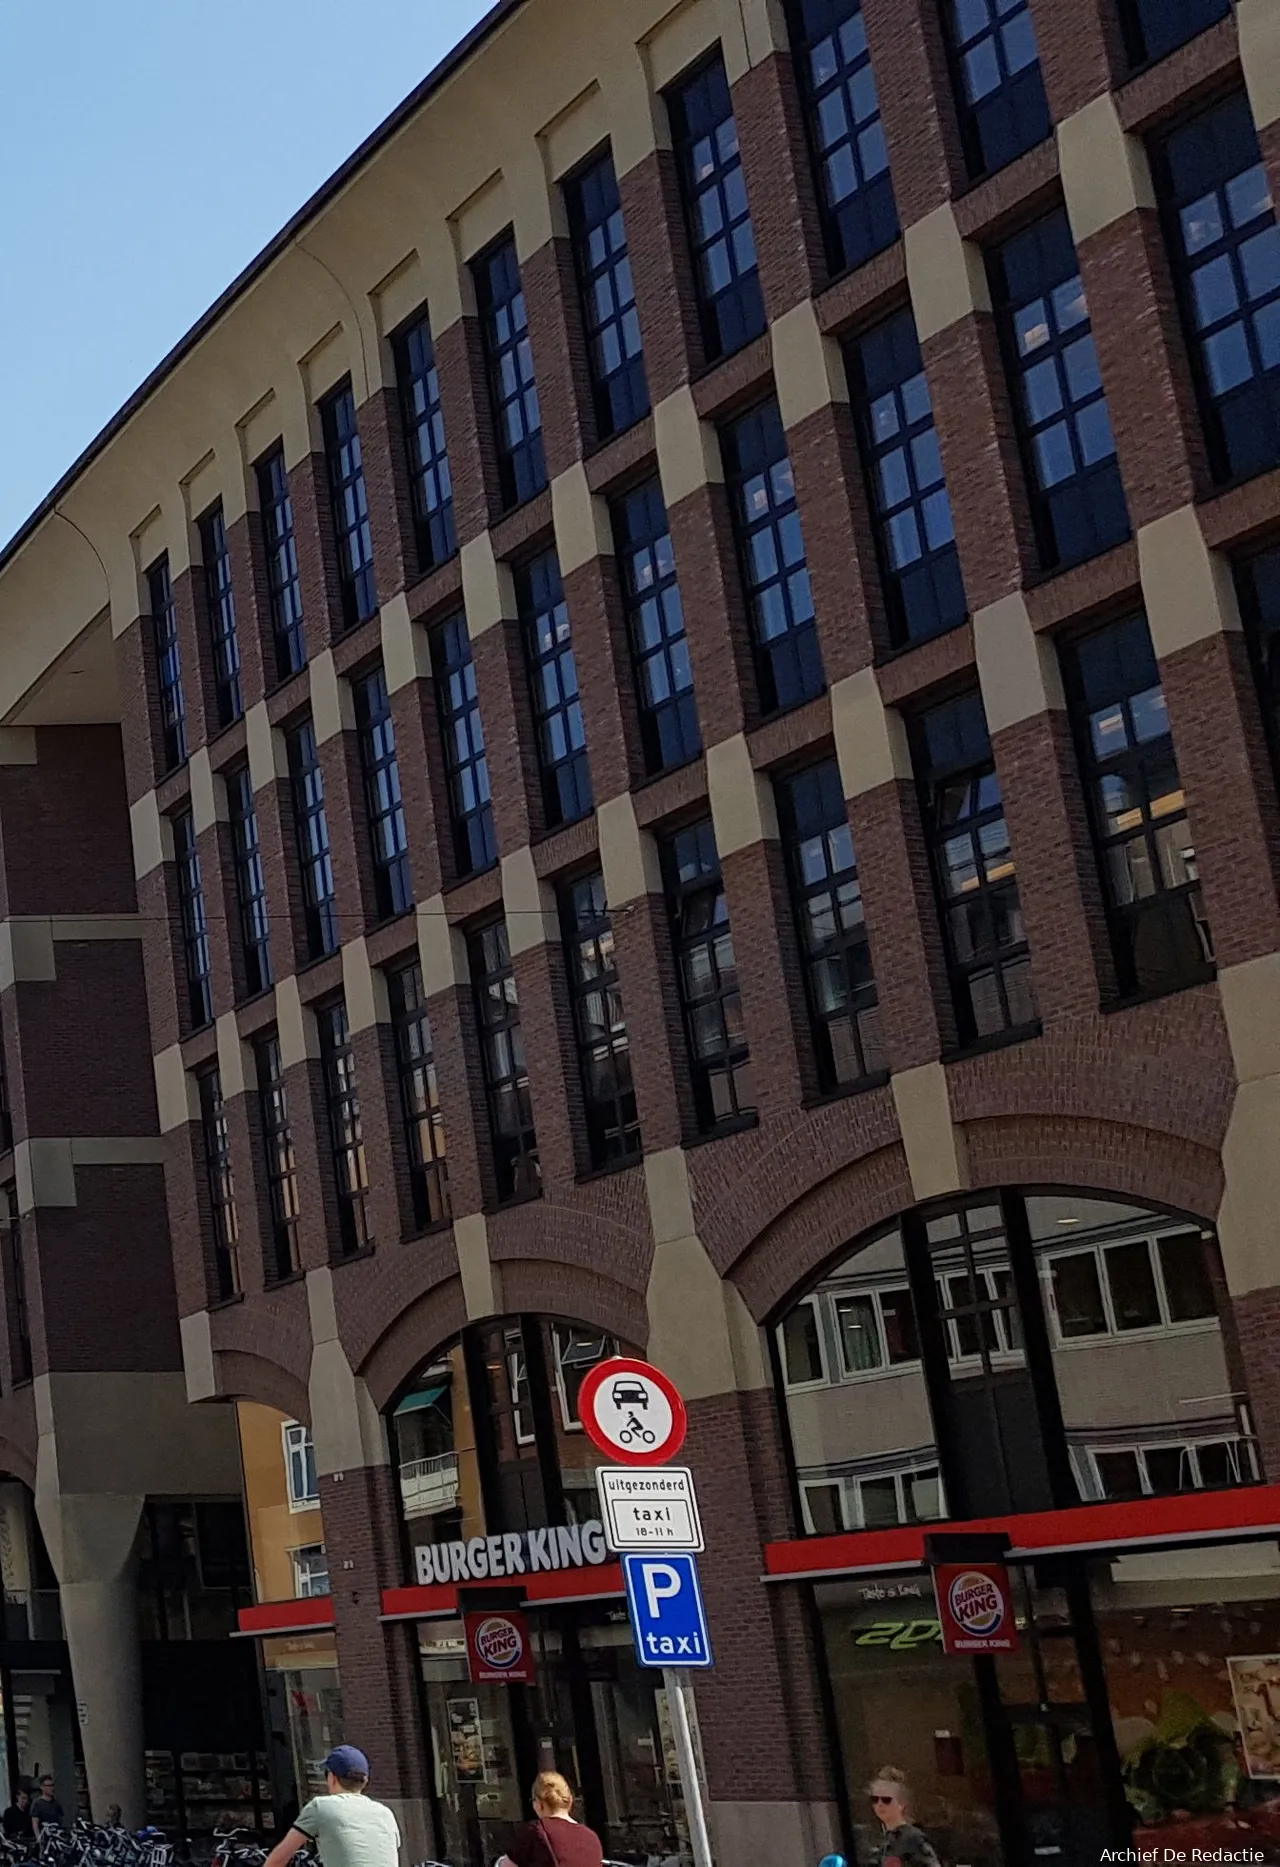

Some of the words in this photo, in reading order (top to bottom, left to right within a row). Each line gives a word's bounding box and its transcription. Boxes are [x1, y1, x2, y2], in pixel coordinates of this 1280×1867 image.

[609, 1479, 684, 1494] uitgezonderd
[633, 1507, 670, 1520] taxi
[667, 1528, 673, 1536] h
[415, 1532, 525, 1586] BURGER
[527, 1519, 606, 1572] KING
[643, 1563, 682, 1618] P
[955, 1583, 993, 1606] BURGER
[958, 1595, 997, 1622] KING
[480, 1627, 514, 1646] BURGER
[483, 1635, 517, 1658] KING
[647, 1631, 700, 1655] taxi
